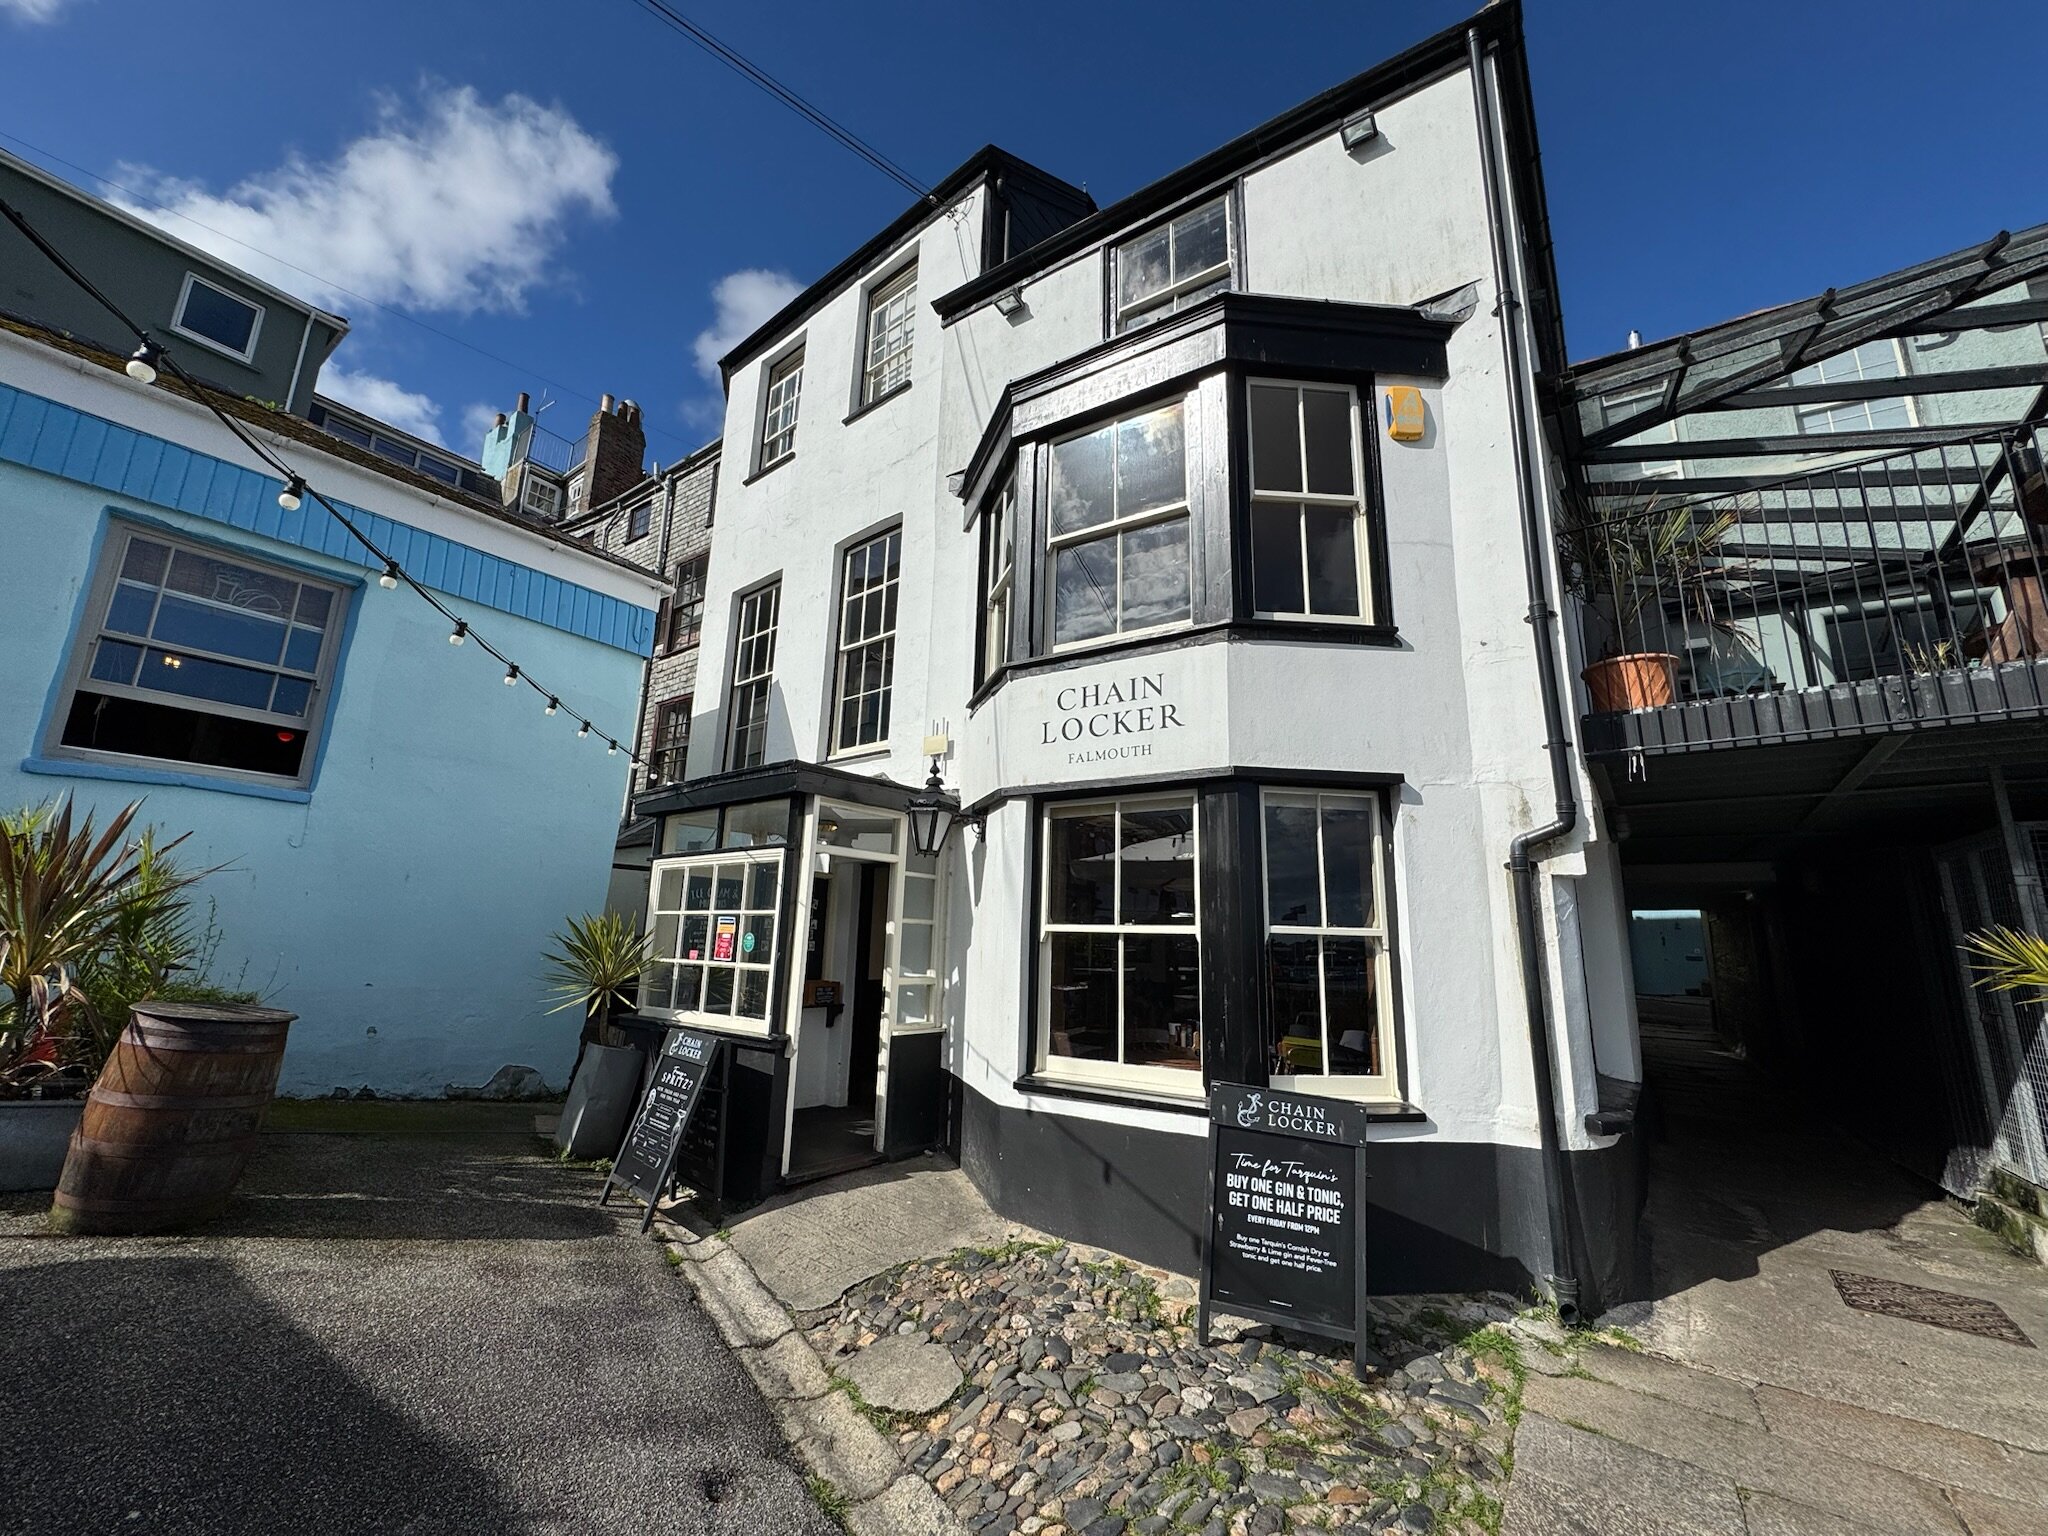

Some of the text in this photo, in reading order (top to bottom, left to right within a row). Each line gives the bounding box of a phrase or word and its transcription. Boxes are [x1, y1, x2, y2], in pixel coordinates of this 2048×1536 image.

[1057, 673, 1165, 711] CHAIN
[1041, 704, 1185, 744] LOCKER
[1068, 744, 1152, 764] FALMOUTH
[1268, 1101, 1325, 1120] CHAIN
[1268, 1113, 1336, 1136] LOCKER
[1230, 1153, 1338, 1184] Time for Tarquin's
[1226, 1173, 1344, 1209] BUY ONE GIN & TONIC,
[1228, 1191, 1341, 1224] GET ONE HALF PRICE
[1247, 1213, 1320, 1235] EVERY FRIDAY FROM 12PM
[1229, 1240, 1261, 1253] Strawberry
[1268, 1248, 1282, 1256] Lime
[1283, 1251, 1293, 1259] gin
[1294, 1253, 1305, 1261] and
[1236, 1233, 1248, 1242] Buy
[1310, 1247, 1322, 1257] Dry
[1294, 1261, 1306, 1269] half
